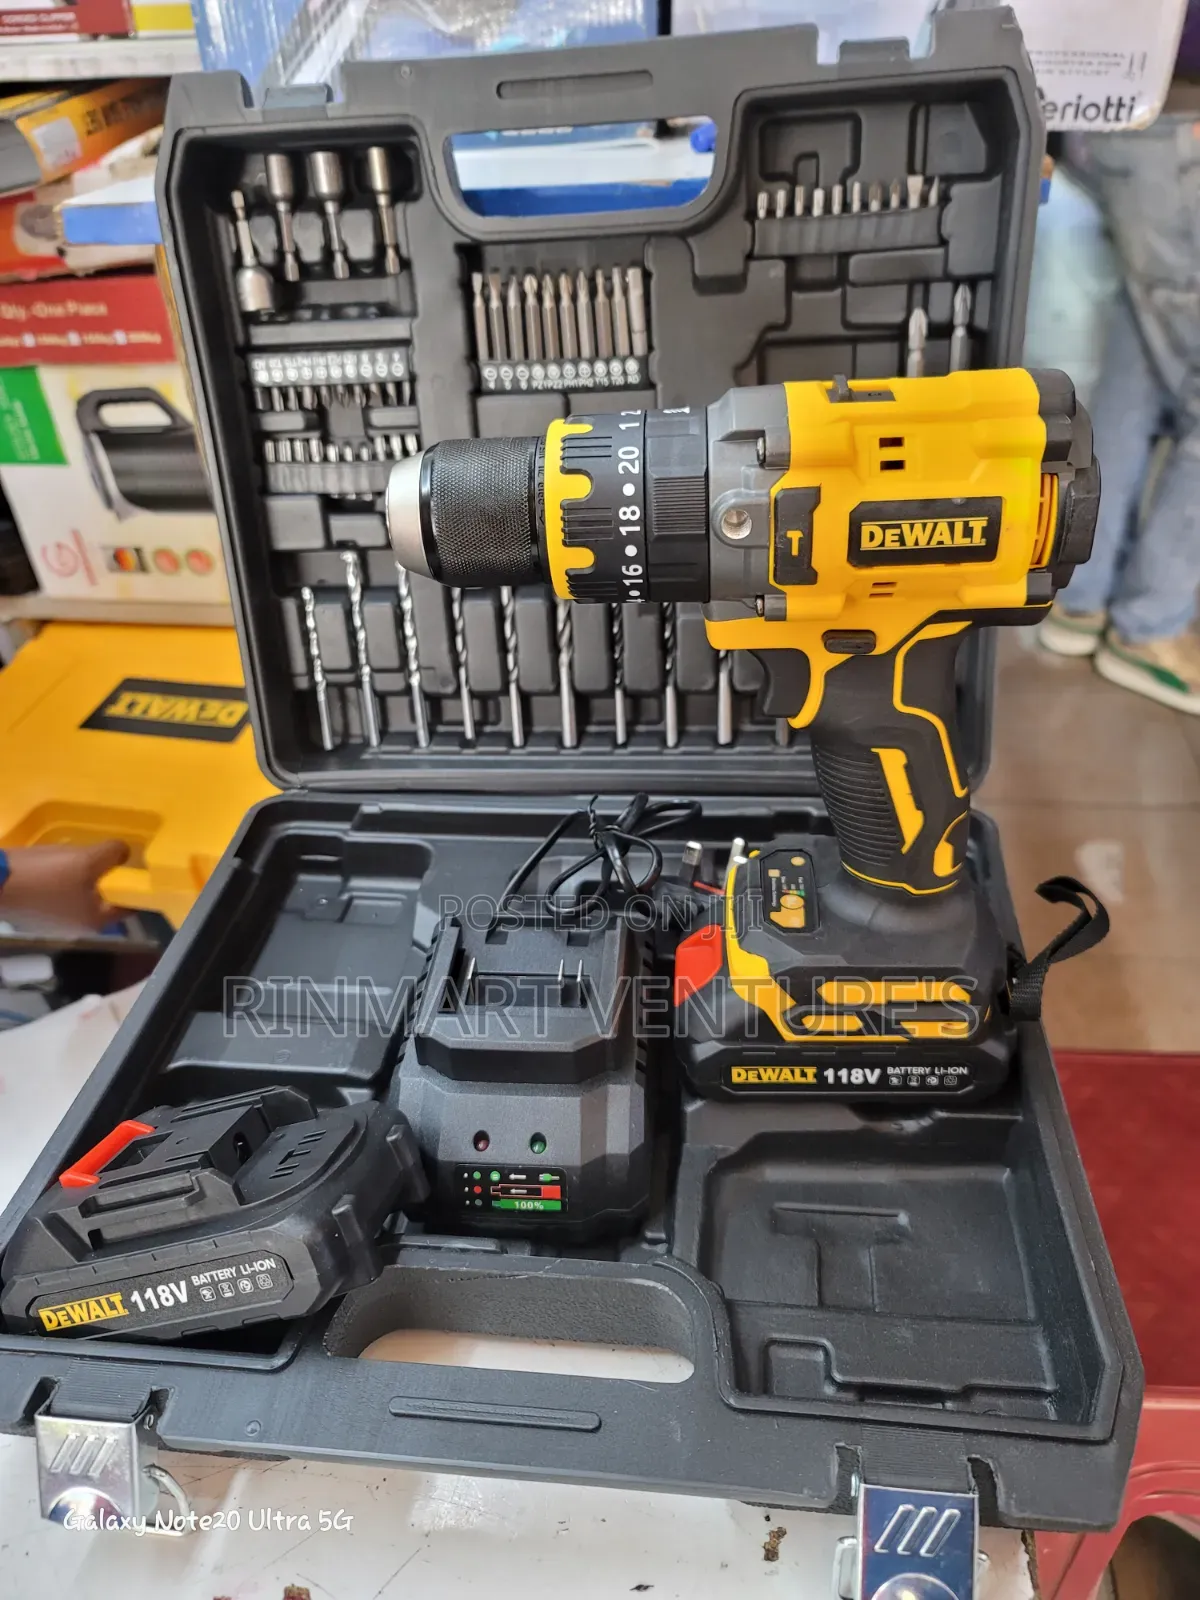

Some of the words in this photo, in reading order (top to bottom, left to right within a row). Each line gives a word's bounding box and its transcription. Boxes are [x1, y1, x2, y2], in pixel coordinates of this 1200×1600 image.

[618, 446, 640, 475] 20
[619, 505, 641, 536] 18
[621, 564, 643, 586] 16
[823, 1068, 881, 1085] 118V
[887, 1066, 931, 1075] BATTERY
[935, 1066, 968, 1075] LI-ION
[514, 1201, 544, 1210] 100%
[191, 1265, 237, 1287] BATTERY
[239, 1257, 277, 1276] LI-ION
[130, 1280, 188, 1313] 118V
